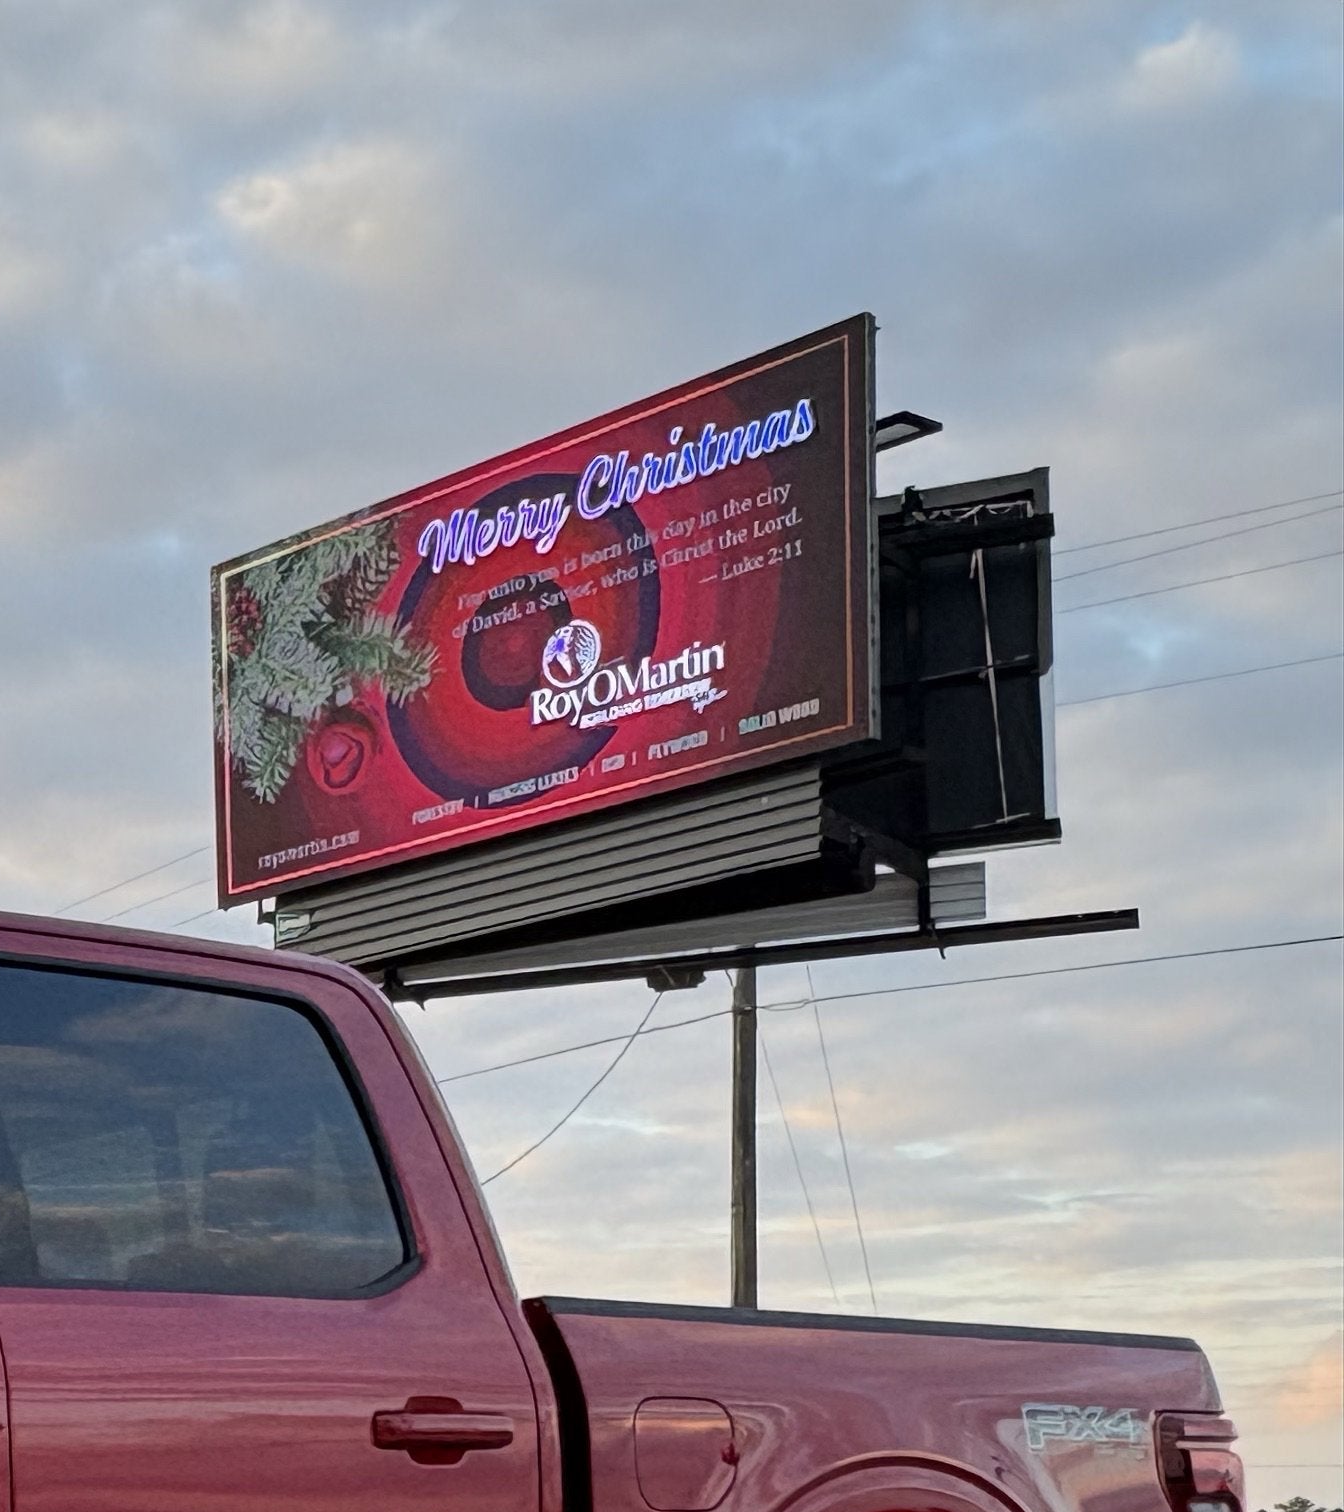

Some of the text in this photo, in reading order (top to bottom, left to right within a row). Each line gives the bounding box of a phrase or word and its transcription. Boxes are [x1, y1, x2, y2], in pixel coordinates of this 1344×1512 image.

[417, 398, 815, 573] Merry Christmas
[452, 619, 469, 638] of
[525, 600, 537, 614] a
[601, 566, 639, 588] who
[642, 558, 658, 577] is
[663, 539, 715, 567] Christ
[719, 528, 748, 549] the
[489, 577, 525, 600] unto
[527, 567, 560, 591] you
[564, 557, 578, 575] is
[581, 543, 622, 569] born
[627, 528, 658, 553] this
[663, 517, 696, 540] day
[699, 510, 720, 529] in
[723, 498, 752, 519] the
[756, 483, 791, 507] city
[721, 553, 764, 581] Luke
[767, 539, 802, 565] 2:11
[530, 641, 726, 726] RoyOMartin
[1021, 1403, 1144, 1450] FX4
